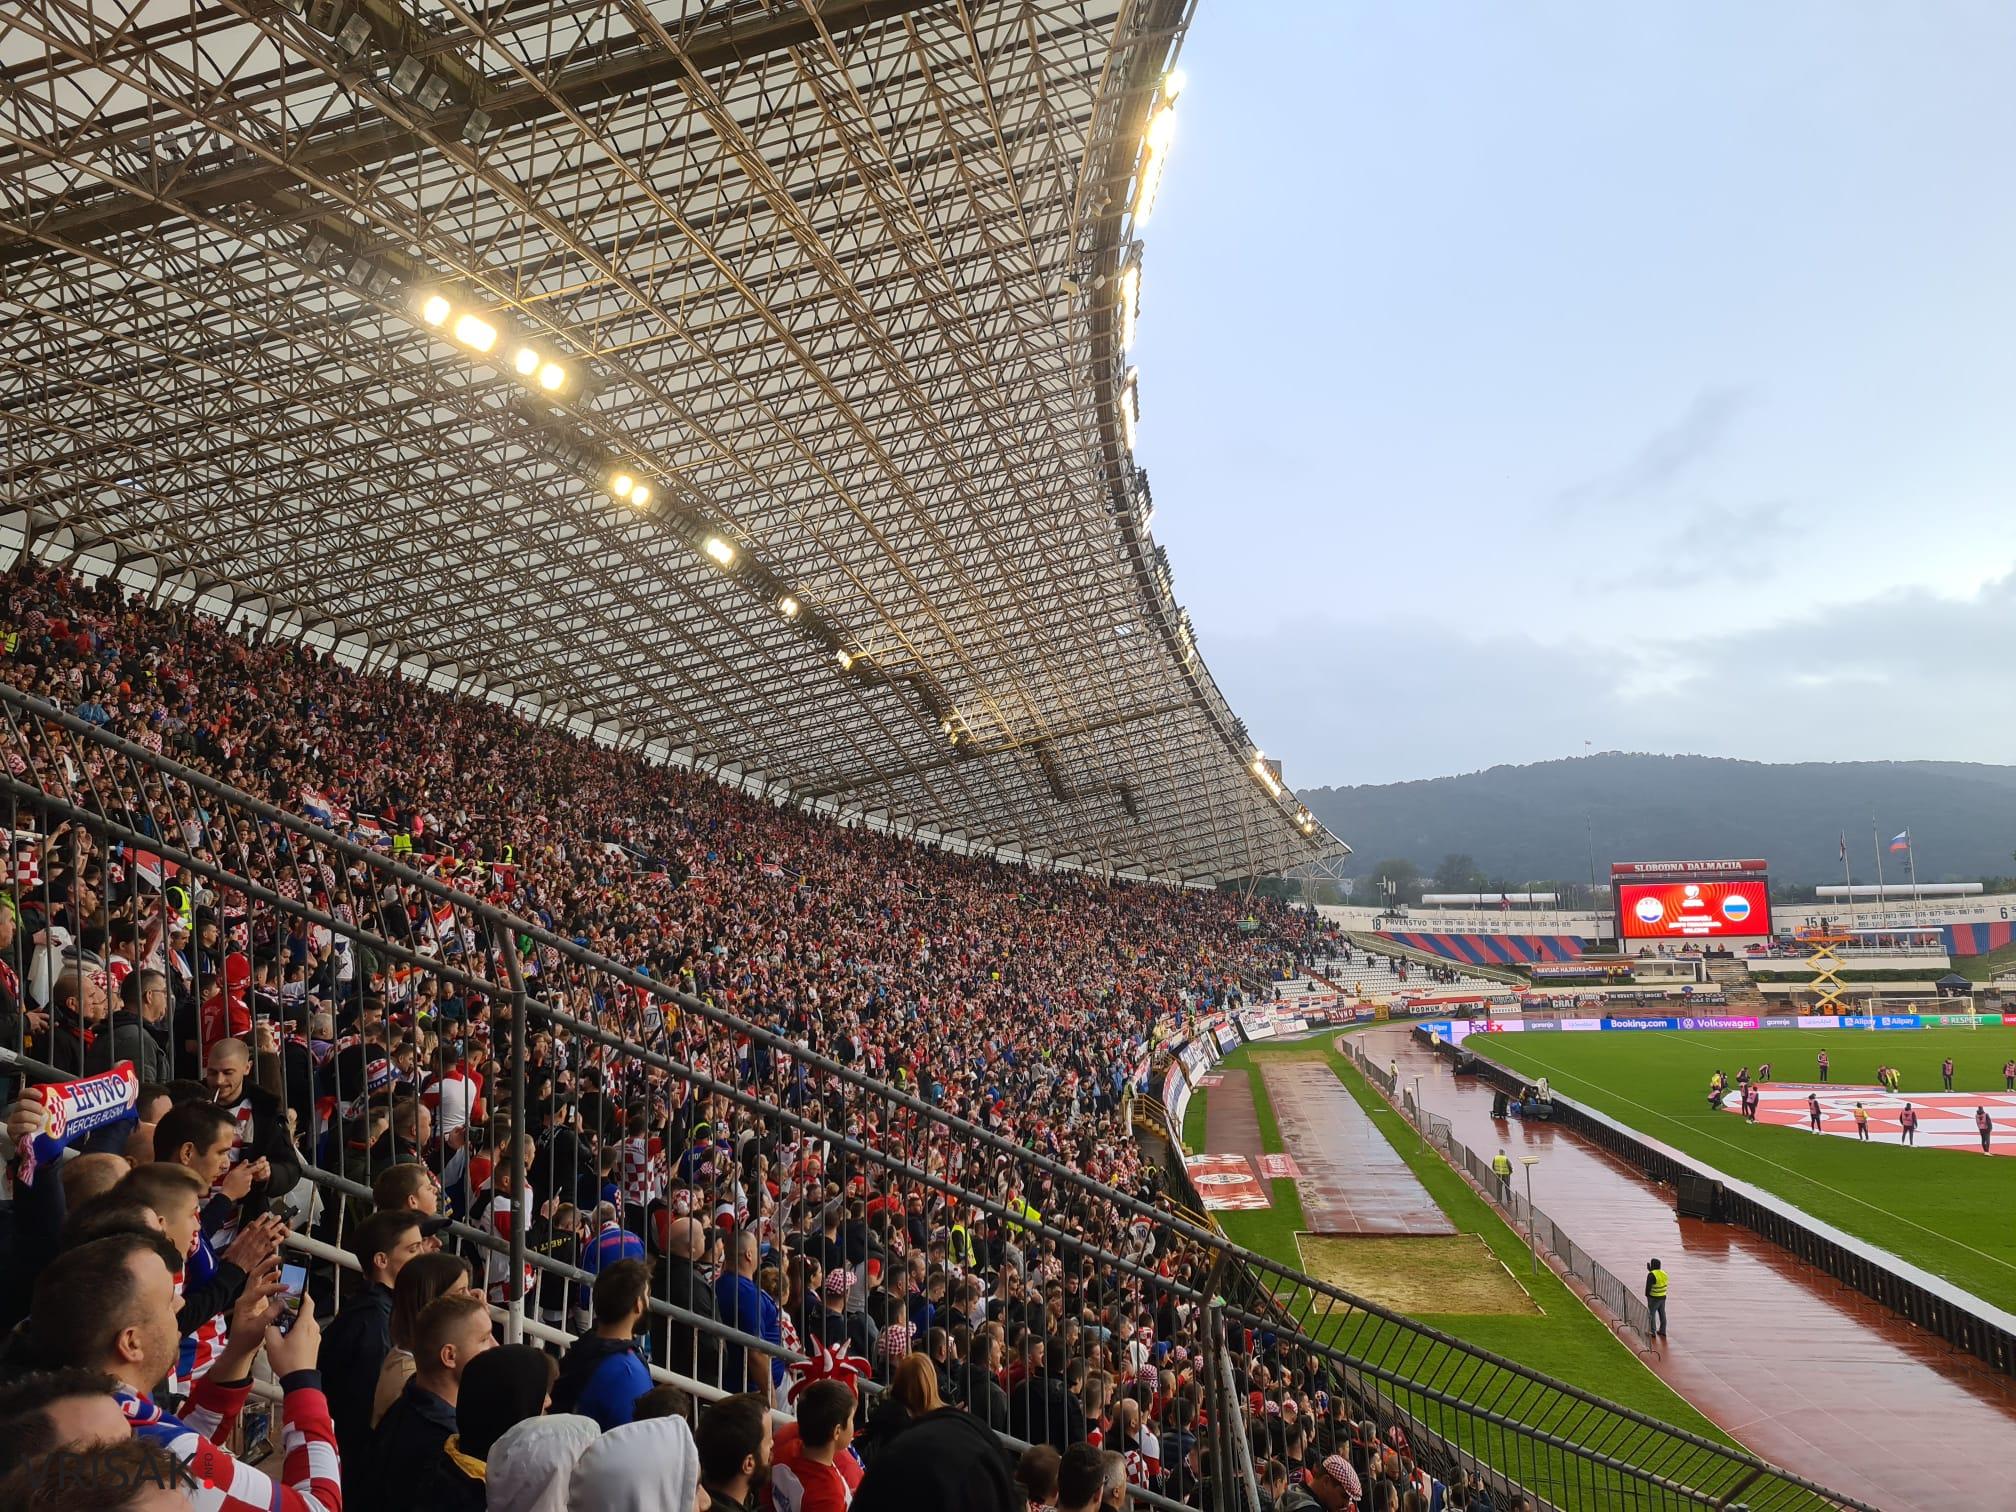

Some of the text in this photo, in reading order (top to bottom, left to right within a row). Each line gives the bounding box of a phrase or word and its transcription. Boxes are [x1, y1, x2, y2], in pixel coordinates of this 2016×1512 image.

[1634, 861, 1742, 872] SLOBODNA DALMACIJA
[2000, 907, 2008, 919] 6
[1372, 918, 1381, 930] 18
[1385, 918, 1427, 926] PRVENSTVO
[1805, 917, 1818, 928] 15
[1552, 999, 1575, 1008] GRAZ
[1469, 1019, 1504, 1034] FedEx
[1531, 1021, 1554, 1029] gorenje
[1610, 1019, 1667, 1029] Booking.com
[1697, 1019, 1755, 1028] Volkswagen
[1766, 1018, 1790, 1026] gorenje
[1891, 1017, 1914, 1026] Alipay
[68, 1074, 126, 1112] LIVNO
